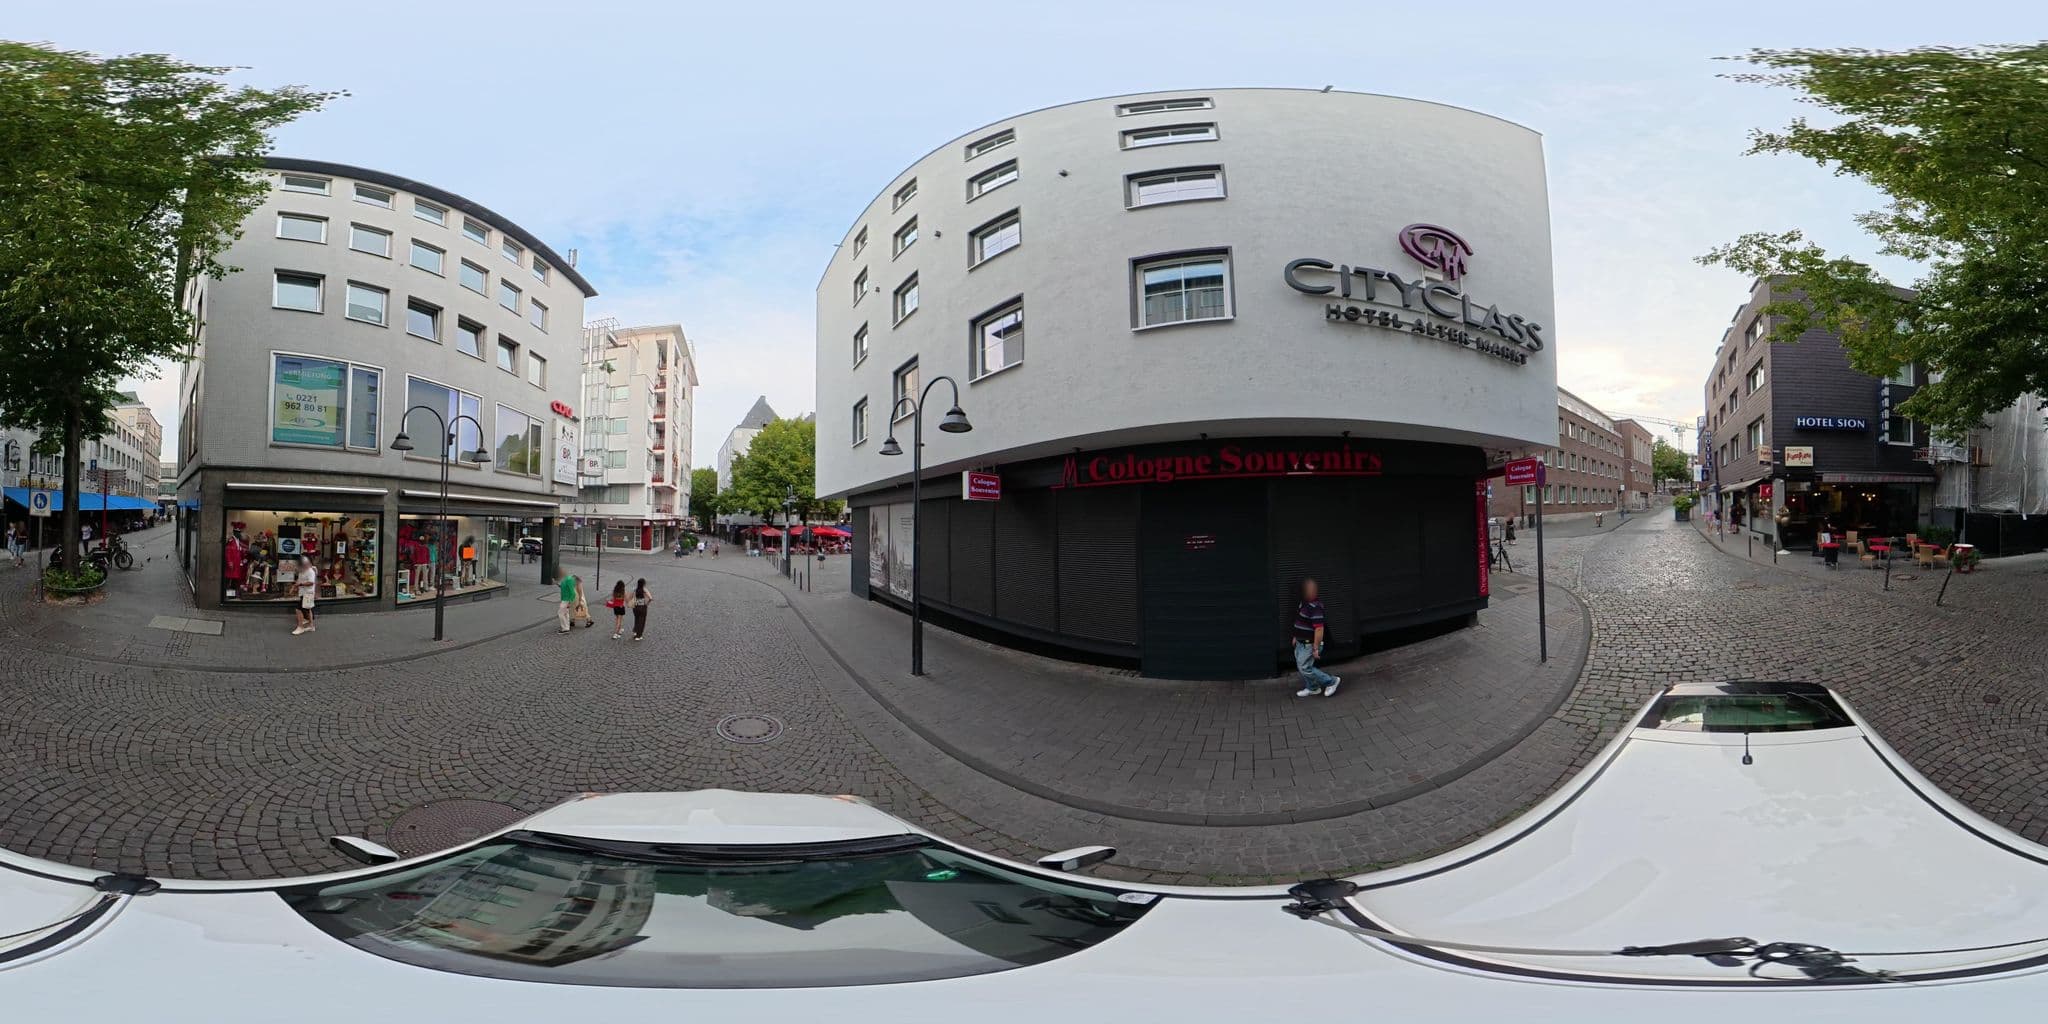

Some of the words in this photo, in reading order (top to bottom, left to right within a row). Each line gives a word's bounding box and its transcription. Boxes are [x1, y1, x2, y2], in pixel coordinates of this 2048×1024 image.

[1284, 258, 1544, 351] CITYCLASS
[1325, 303, 1403, 329] HOTEL
[1411, 318, 1471, 346] ALTER
[1475, 336, 1529, 366] MARKT
[296, 394, 317, 403] 0221
[285, 402, 301, 411] 962
[304, 404, 315, 412] 80
[317, 405, 327, 413] 81
[551, 401, 573, 418] CDU
[1797, 417, 1835, 427] HOTEL
[1837, 418, 1865, 429] SION
[1088, 453, 1212, 482] Cologne
[1220, 444, 1383, 473] Souvenirs
[1511, 465, 1532, 473] Cologne
[973, 477, 997, 486] Cologne
[971, 486, 1000, 495] Souvenirs
